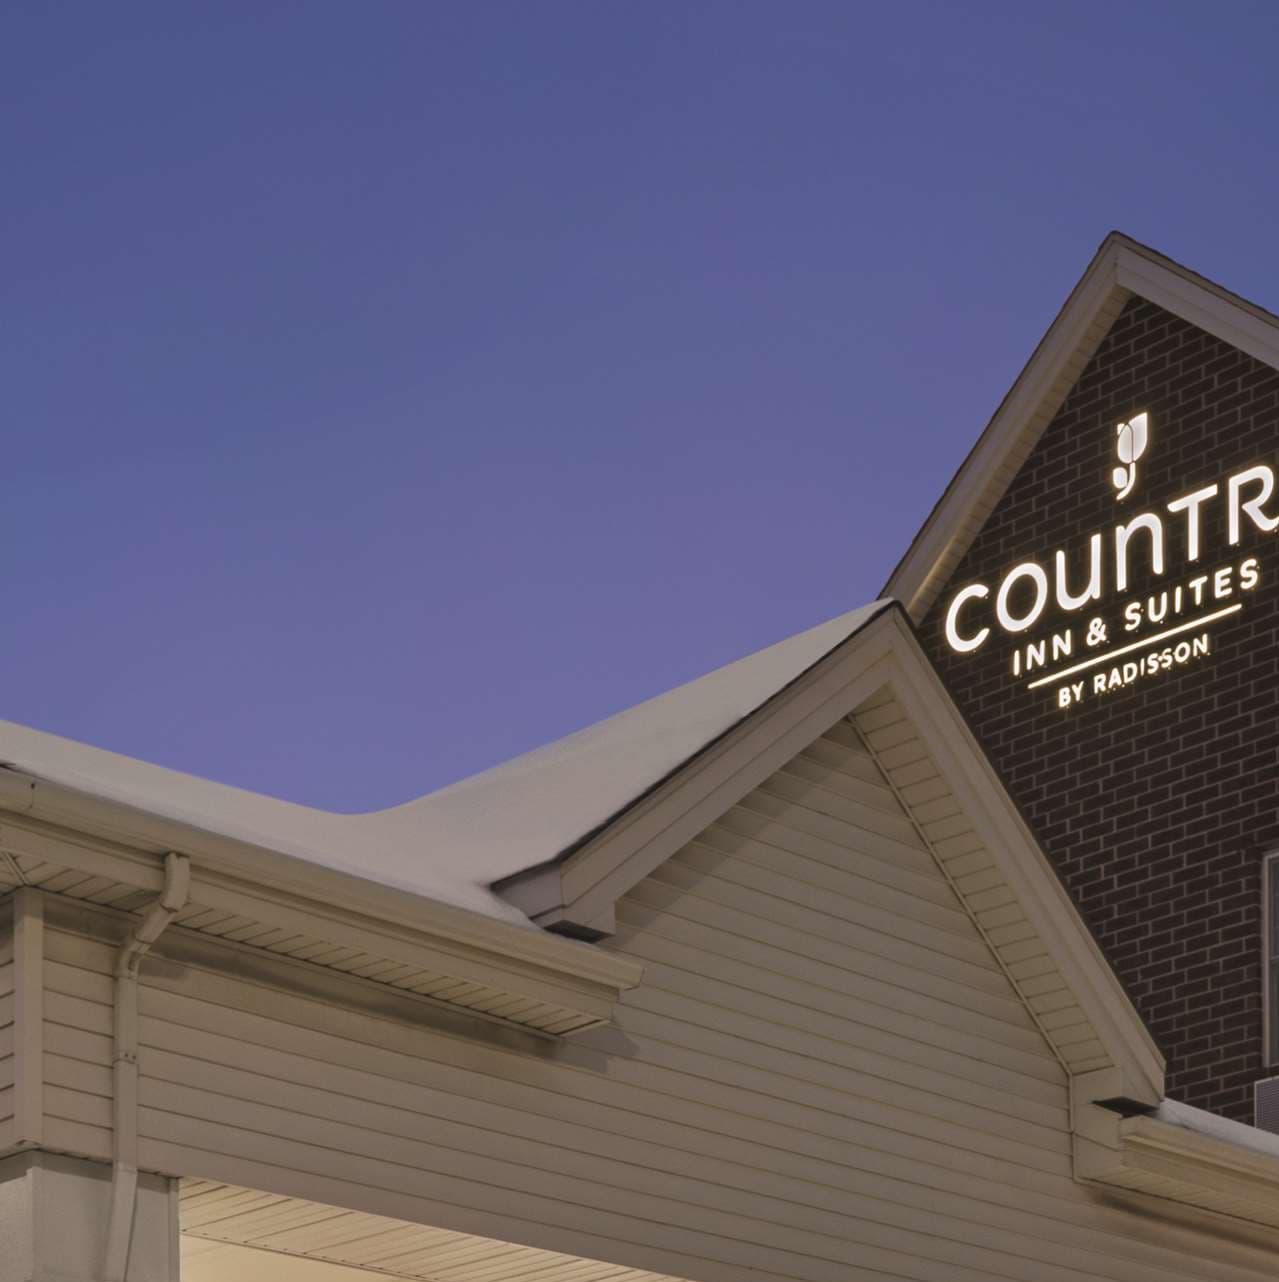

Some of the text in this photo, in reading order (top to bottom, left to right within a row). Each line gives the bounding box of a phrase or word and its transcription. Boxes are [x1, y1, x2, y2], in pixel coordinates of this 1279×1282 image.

[1012, 557, 1259, 677] INN & SUITES
[1057, 632, 1209, 708] BY RADISSON
